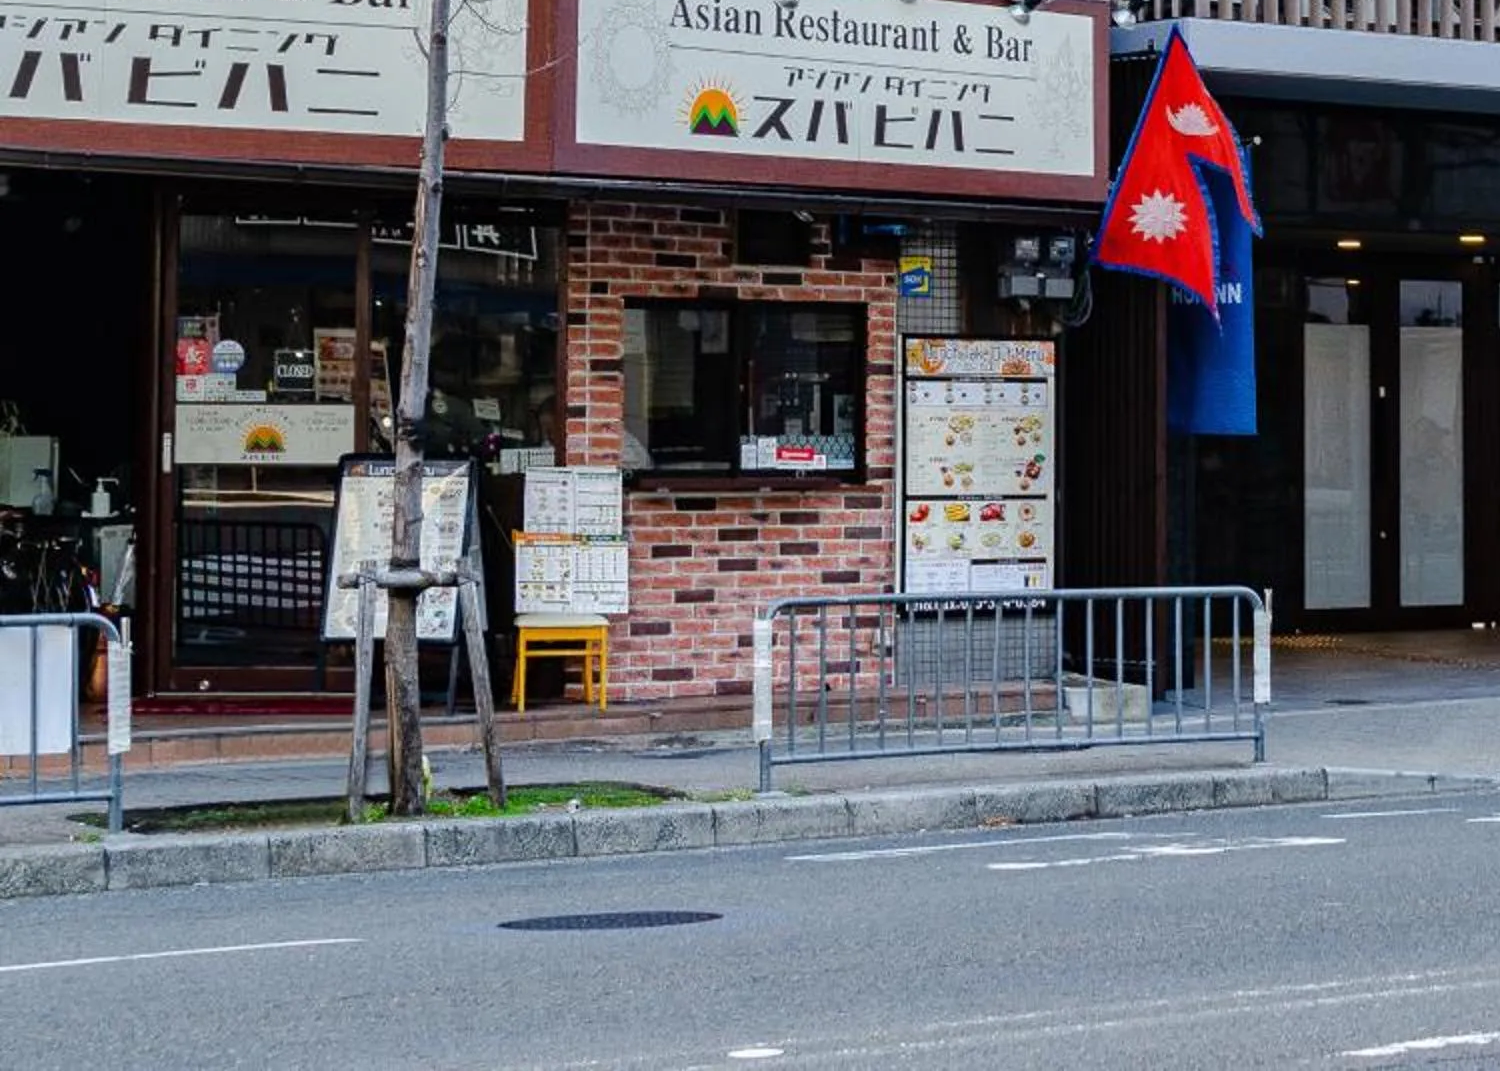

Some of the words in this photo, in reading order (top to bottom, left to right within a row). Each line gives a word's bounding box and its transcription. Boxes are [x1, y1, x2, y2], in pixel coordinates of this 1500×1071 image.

[773, 0, 940, 54] Restaurant
[953, 24, 974, 55] &
[985, 25, 1033, 62] Bar
[276, 365, 314, 378] CLOSED
